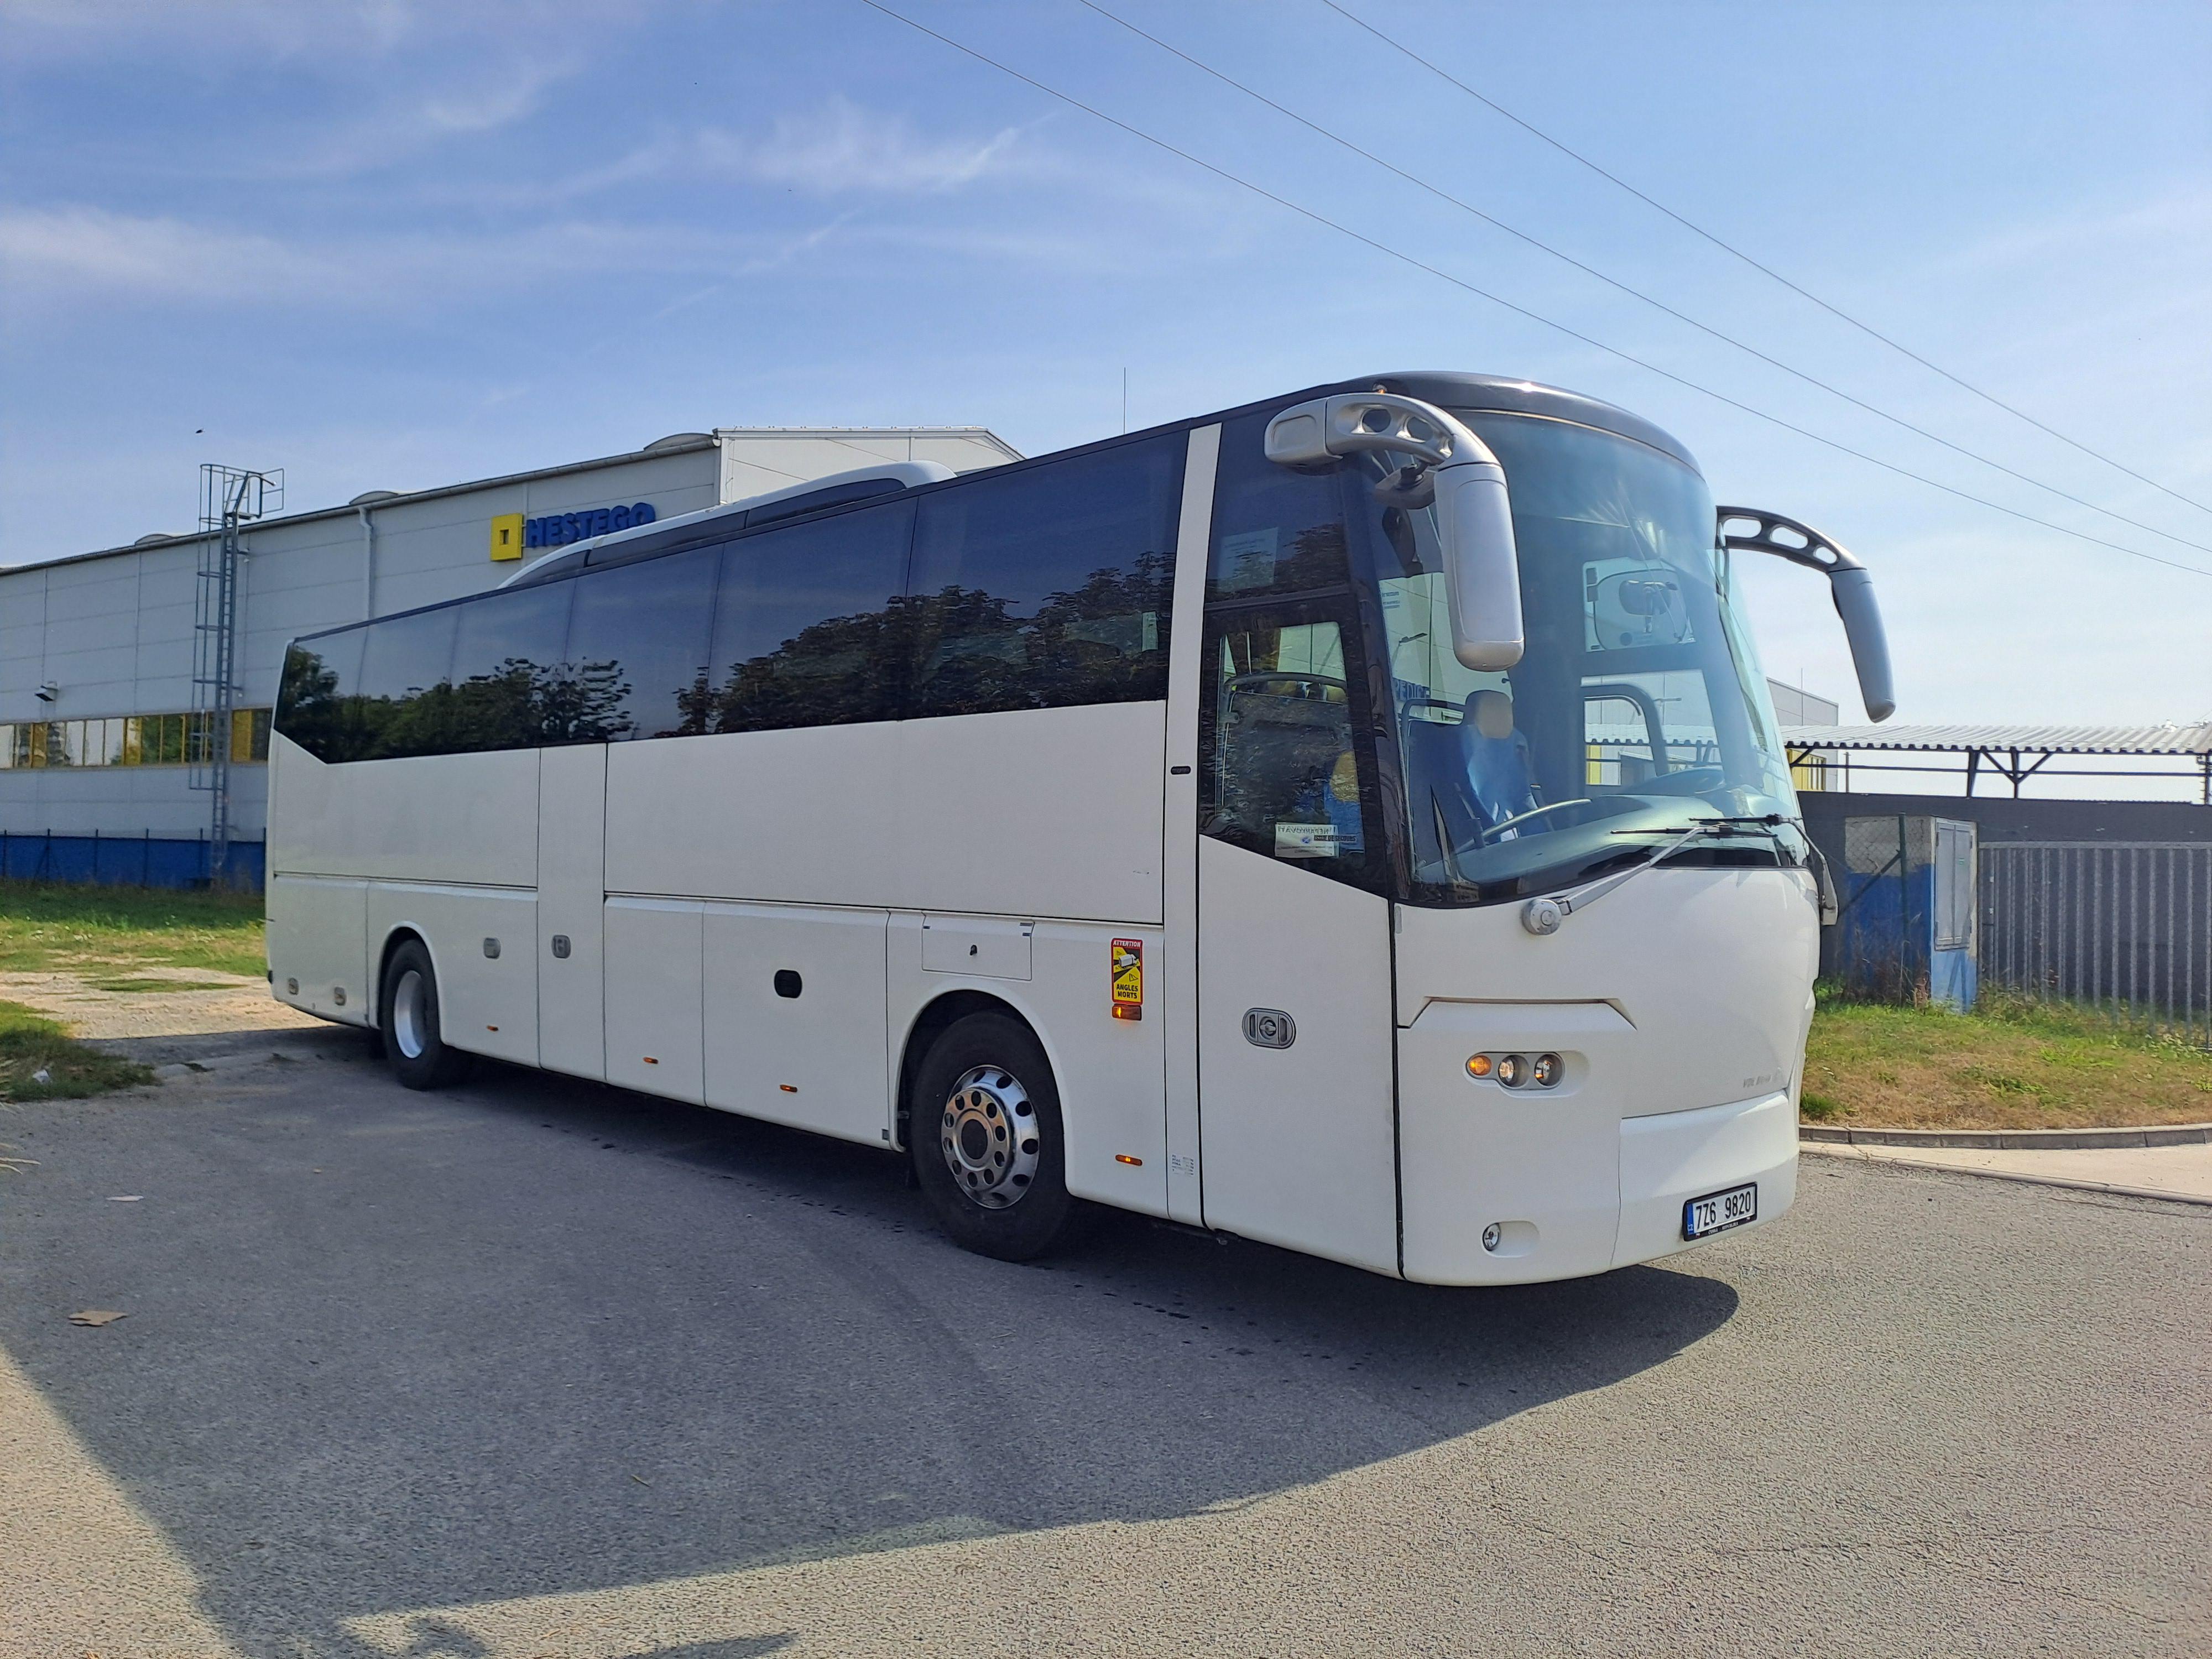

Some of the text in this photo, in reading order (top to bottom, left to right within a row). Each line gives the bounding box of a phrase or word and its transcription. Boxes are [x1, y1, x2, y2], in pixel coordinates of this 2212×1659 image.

[526, 502, 656, 547] HESTEGO
[1695, 1191, 1751, 1230] 7Z6 9820
